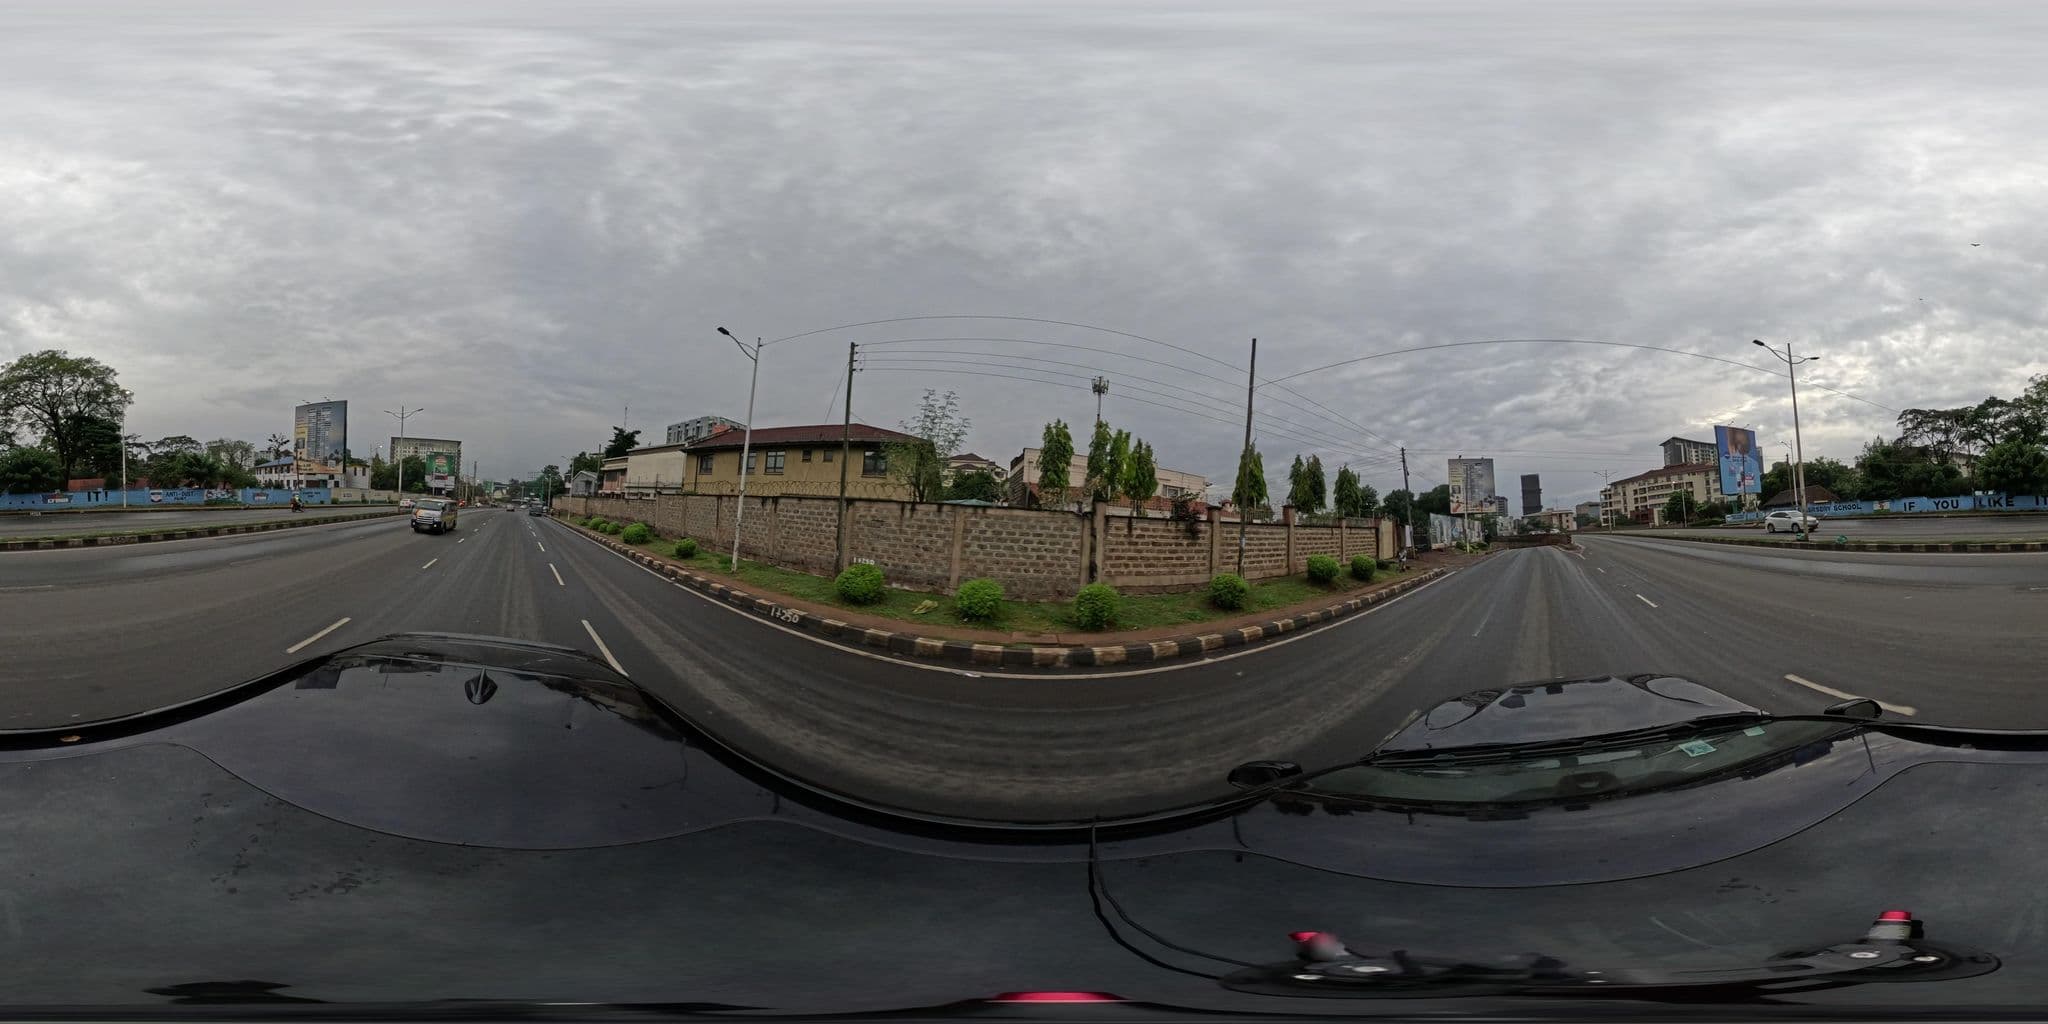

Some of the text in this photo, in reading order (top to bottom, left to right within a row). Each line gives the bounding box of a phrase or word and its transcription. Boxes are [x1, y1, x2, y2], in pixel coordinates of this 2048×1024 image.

[1833, 503, 1862, 511] SCHOOL
[1903, 502, 1915, 511] IF
[1933, 499, 1960, 510] YOU
